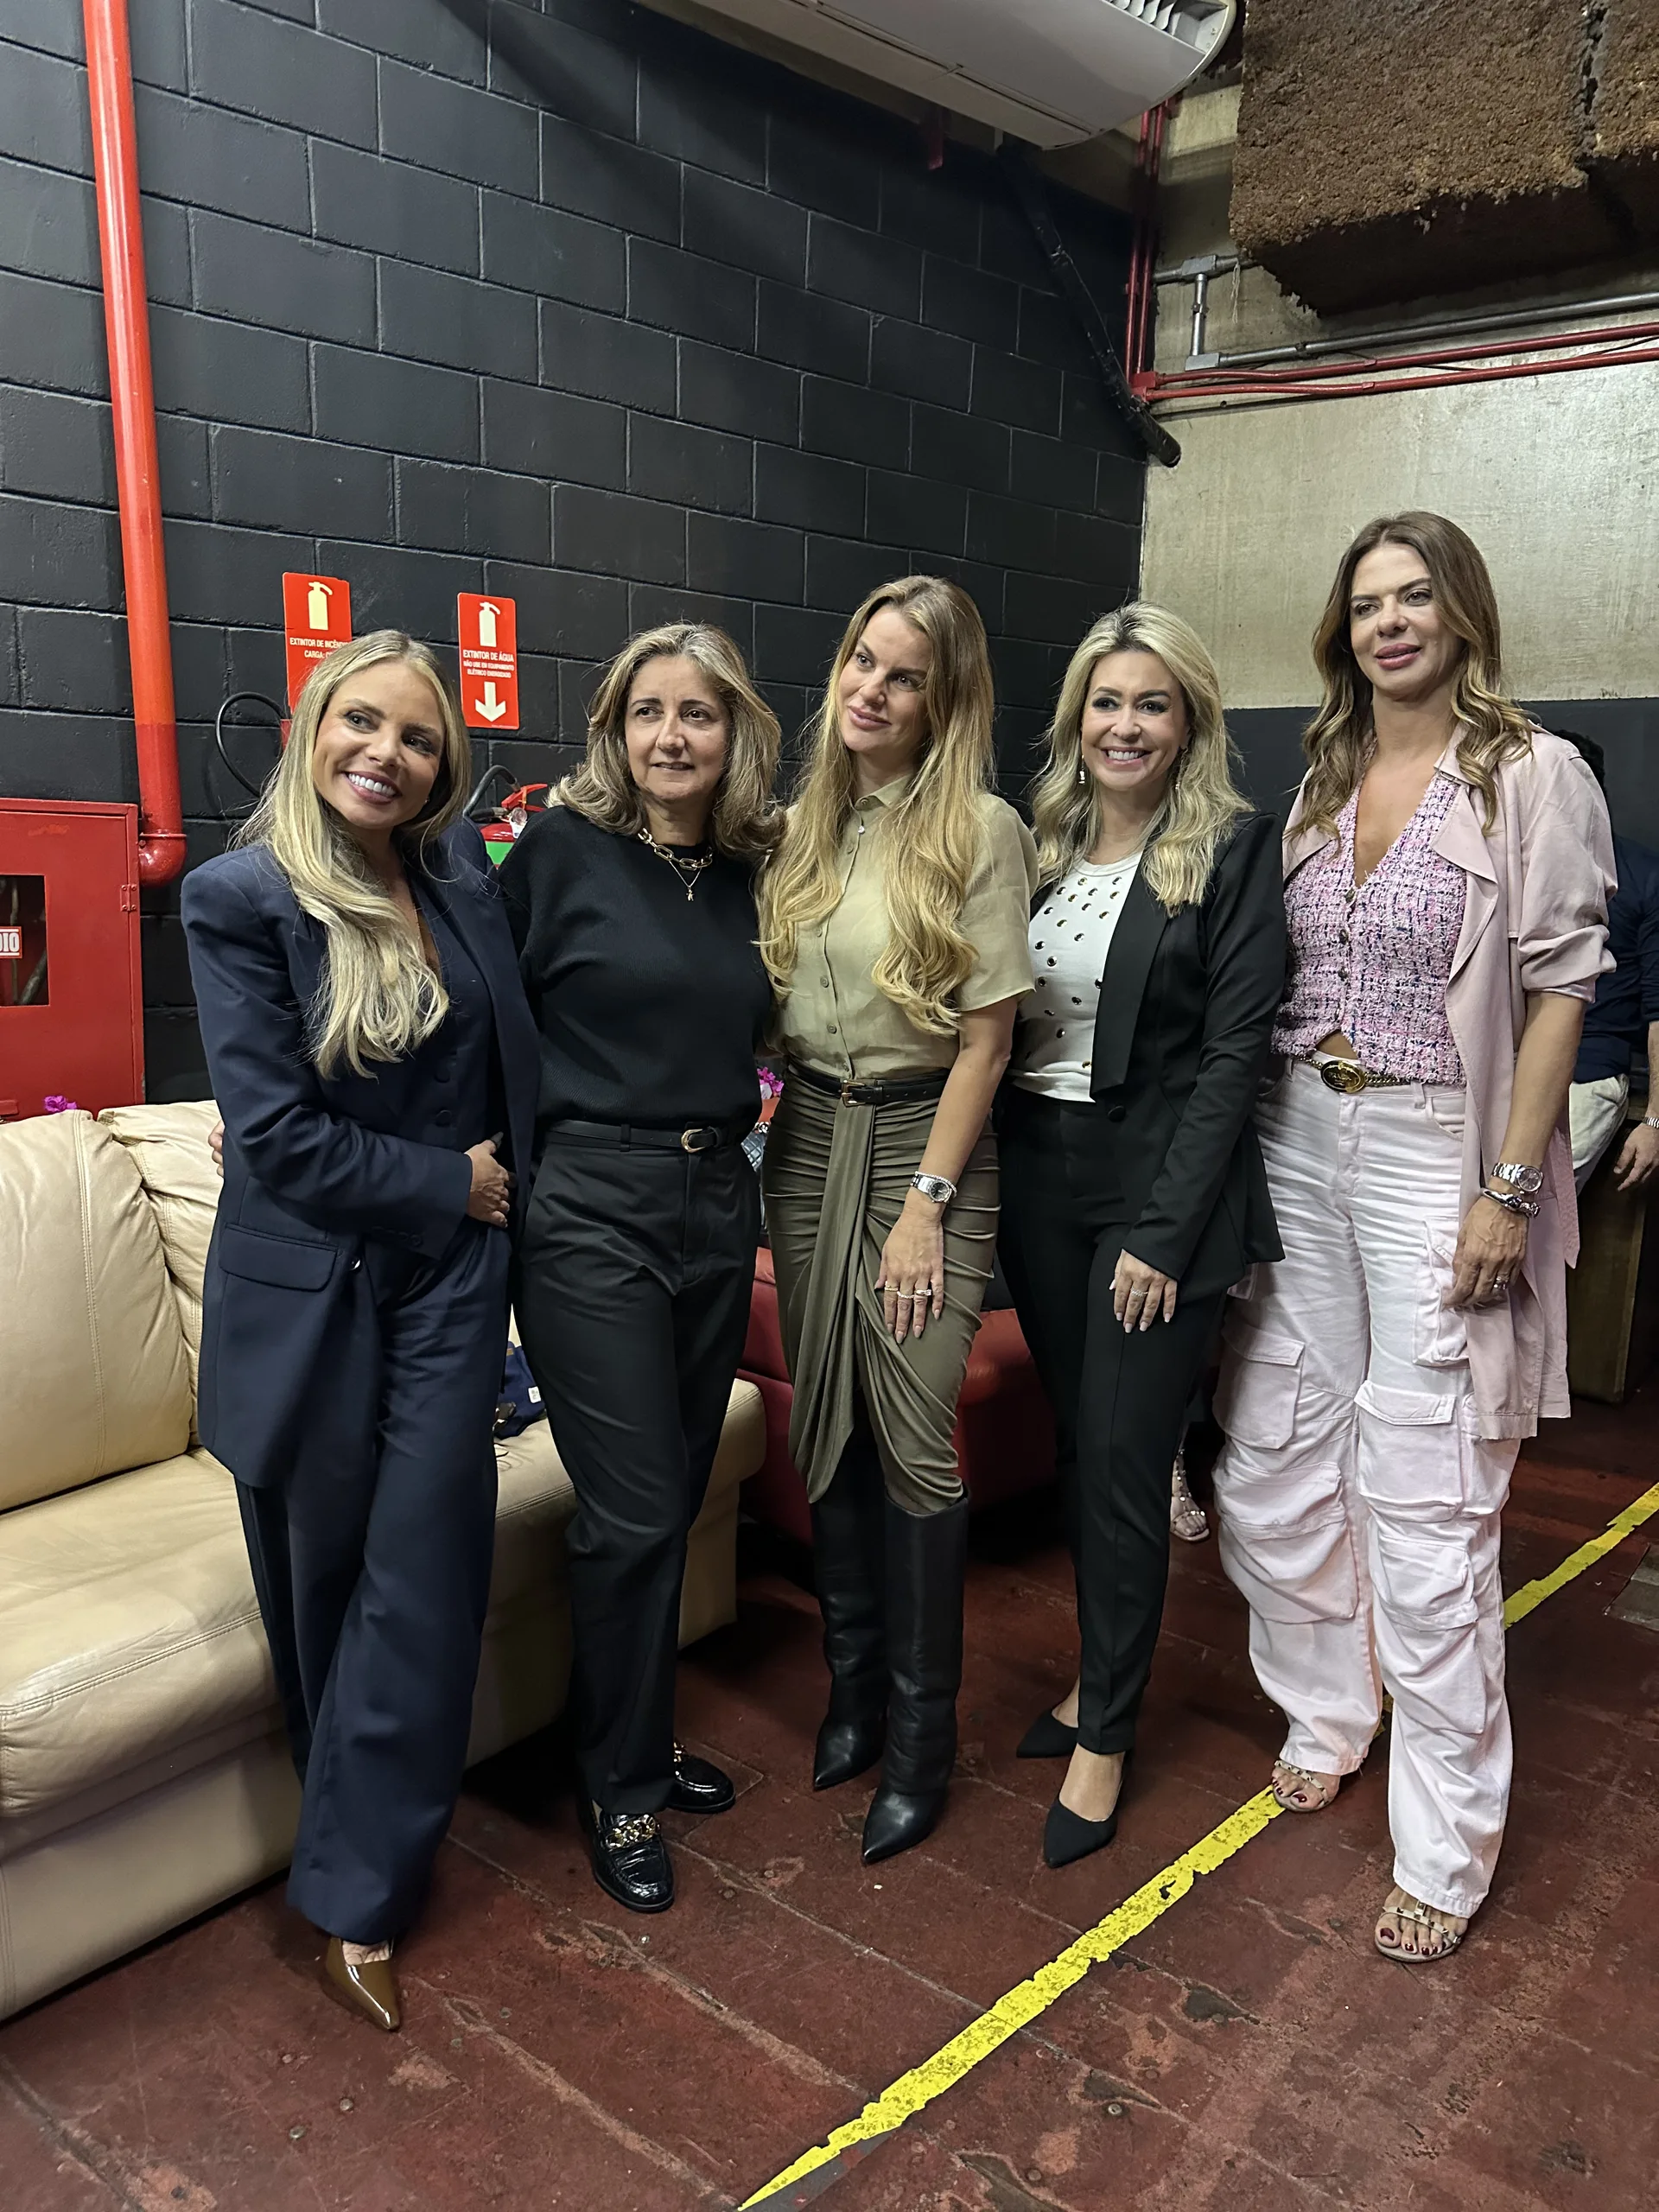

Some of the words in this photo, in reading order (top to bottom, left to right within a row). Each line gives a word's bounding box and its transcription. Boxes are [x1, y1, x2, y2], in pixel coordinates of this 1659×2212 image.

[289, 638, 315, 646] EXTINTOR
[463, 649, 490, 660] EXTINTOR
[490, 652, 499, 661] DE
[499, 651, 514, 662] ÁGUA
[0, 932, 20, 952] IO
